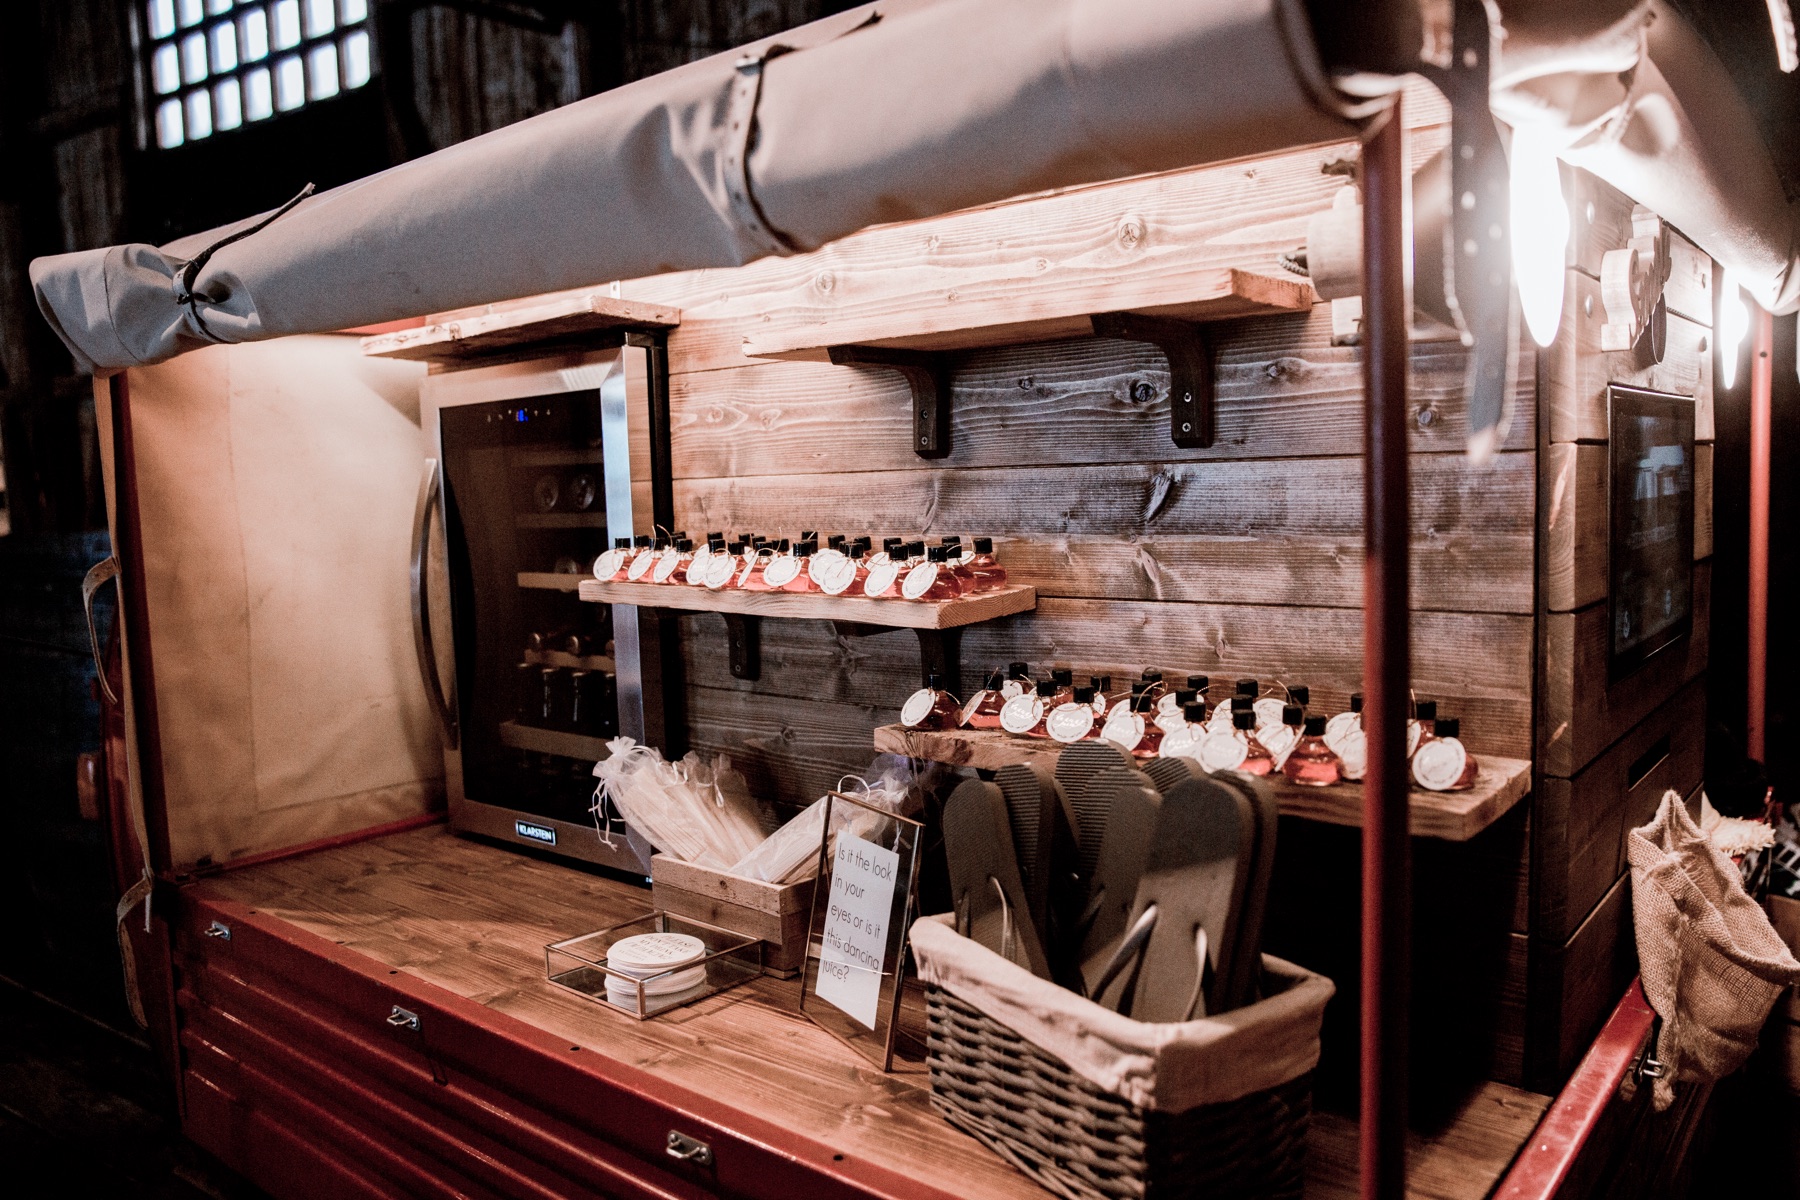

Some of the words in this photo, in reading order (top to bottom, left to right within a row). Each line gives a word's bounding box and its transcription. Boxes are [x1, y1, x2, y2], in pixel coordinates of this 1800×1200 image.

[519, 824, 552, 841] KLARSTEIN
[838, 842, 846, 860] Is
[847, 849, 854, 864] it
[855, 850, 870, 871] the
[872, 856, 892, 881] look
[834, 873, 843, 889] in
[844, 881, 865, 898] your
[830, 904, 852, 924] eyes
[853, 916, 864, 930] or
[865, 919, 872, 935] is
[874, 923, 881, 939] it
[826, 927, 841, 949] this
[843, 936, 879, 974] dancing
[822, 960, 850, 982] juice?
